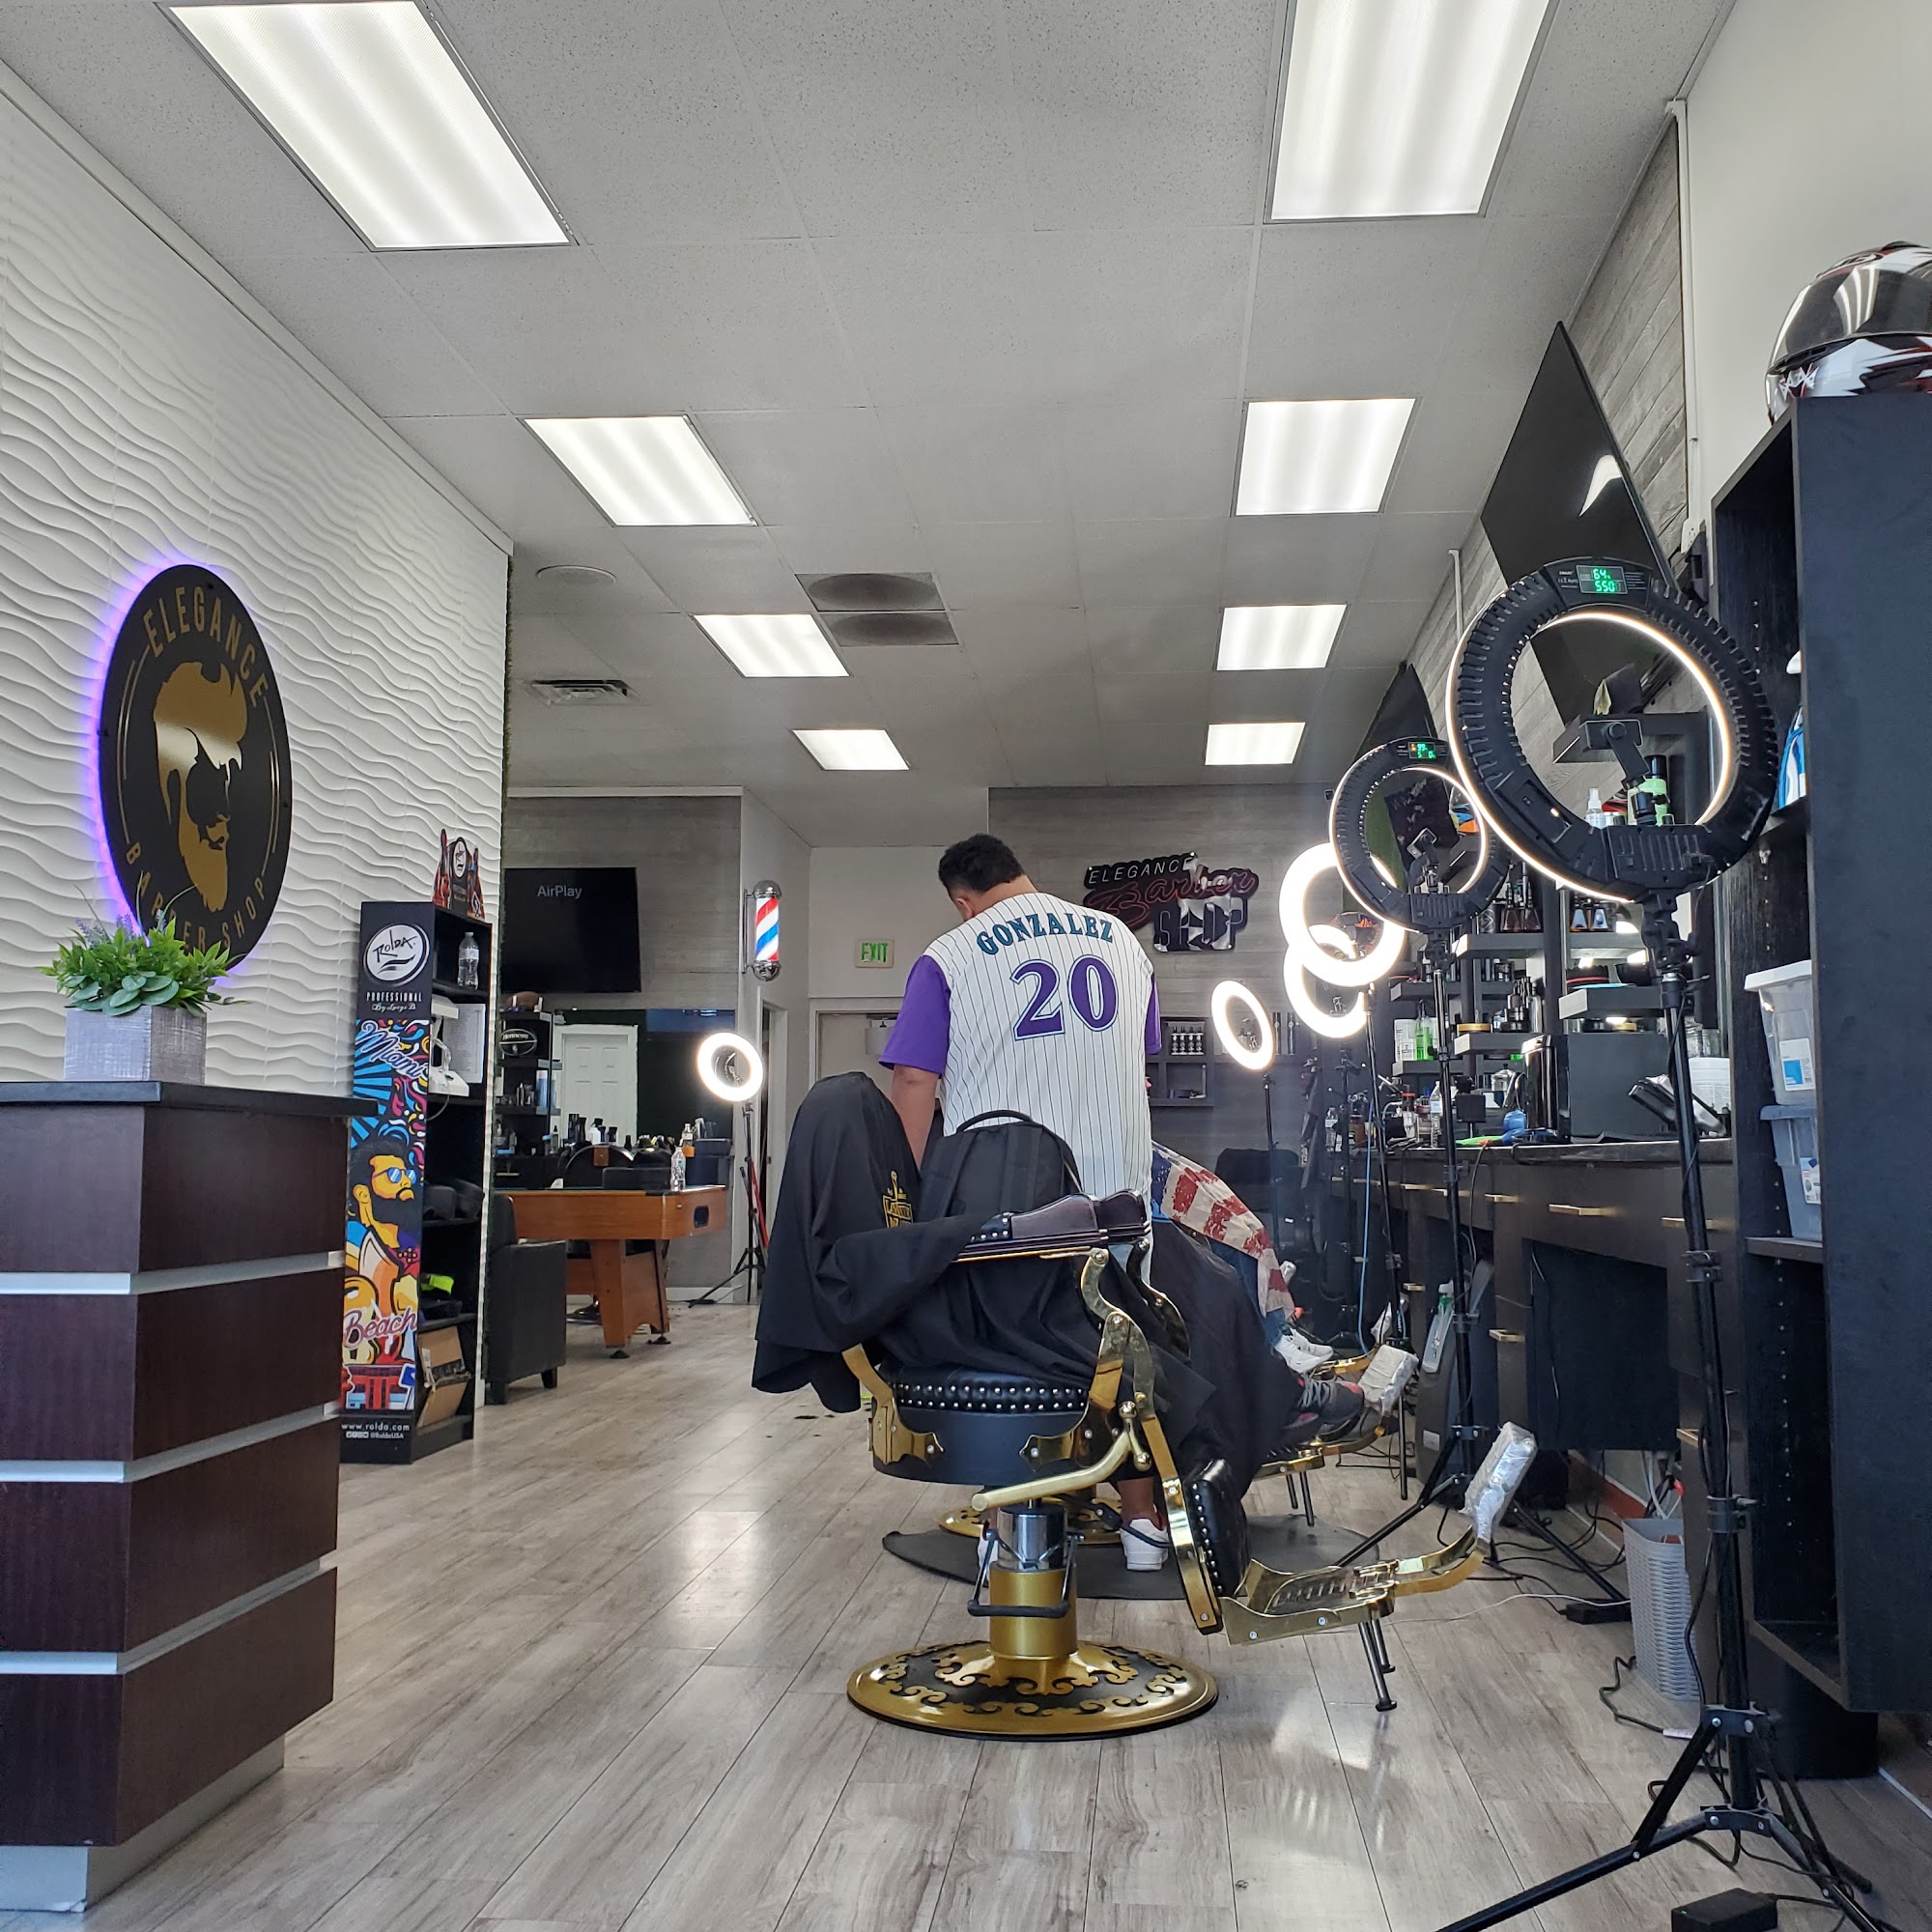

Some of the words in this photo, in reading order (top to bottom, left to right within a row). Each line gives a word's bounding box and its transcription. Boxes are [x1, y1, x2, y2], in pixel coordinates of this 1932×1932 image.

[143, 586, 269, 708] ELEGANCE
[1089, 856, 1197, 884] ELEGANCE
[537, 885, 582, 899] AirPlay
[1088, 865, 1255, 926] Barber
[977, 913, 1113, 955] GONZALEZ
[1159, 896, 1244, 947] SHOP
[861, 942, 889, 962] EXIT
[366, 991, 422, 1003] PROFESSIONAL
[1009, 953, 1119, 1041] 20
[343, 1306, 417, 1349] Beach
[340, 1422, 411, 1432] www.rolda.com
